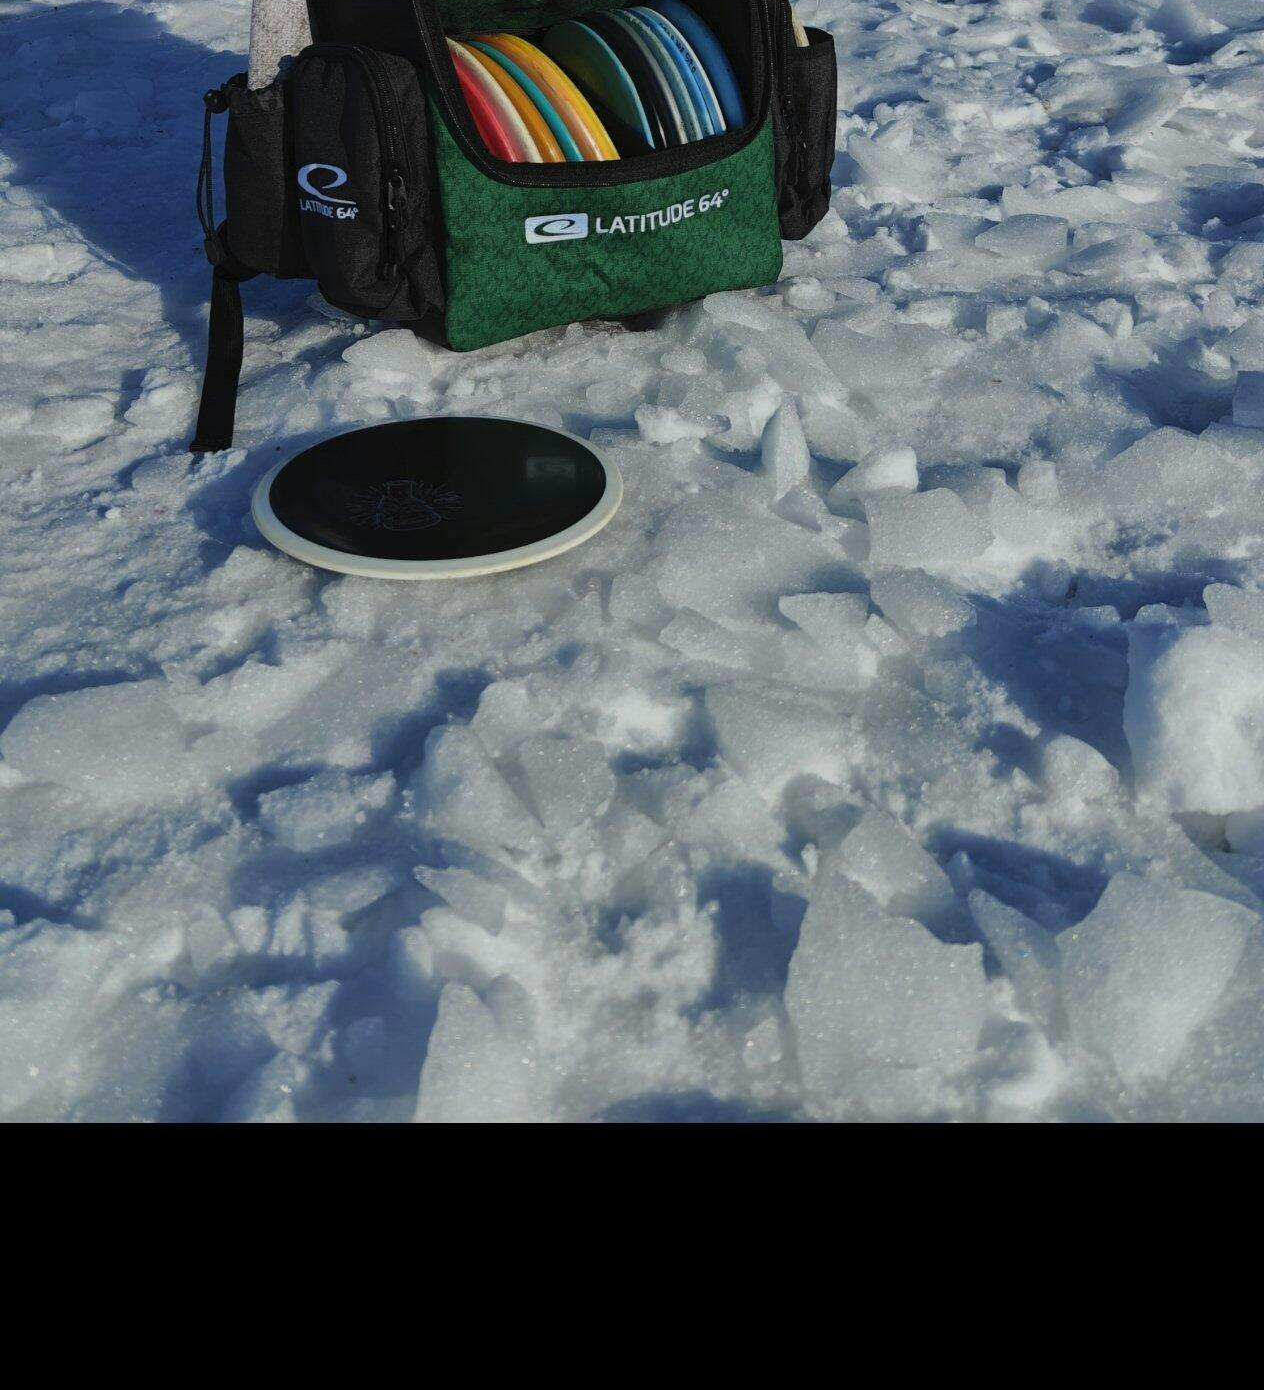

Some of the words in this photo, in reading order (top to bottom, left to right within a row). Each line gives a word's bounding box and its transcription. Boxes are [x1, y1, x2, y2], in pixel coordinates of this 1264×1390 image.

[299, 199, 334, 218] LATITUDE
[595, 199, 695, 234] LATITUDE
[698, 188, 730, 212] 64°
